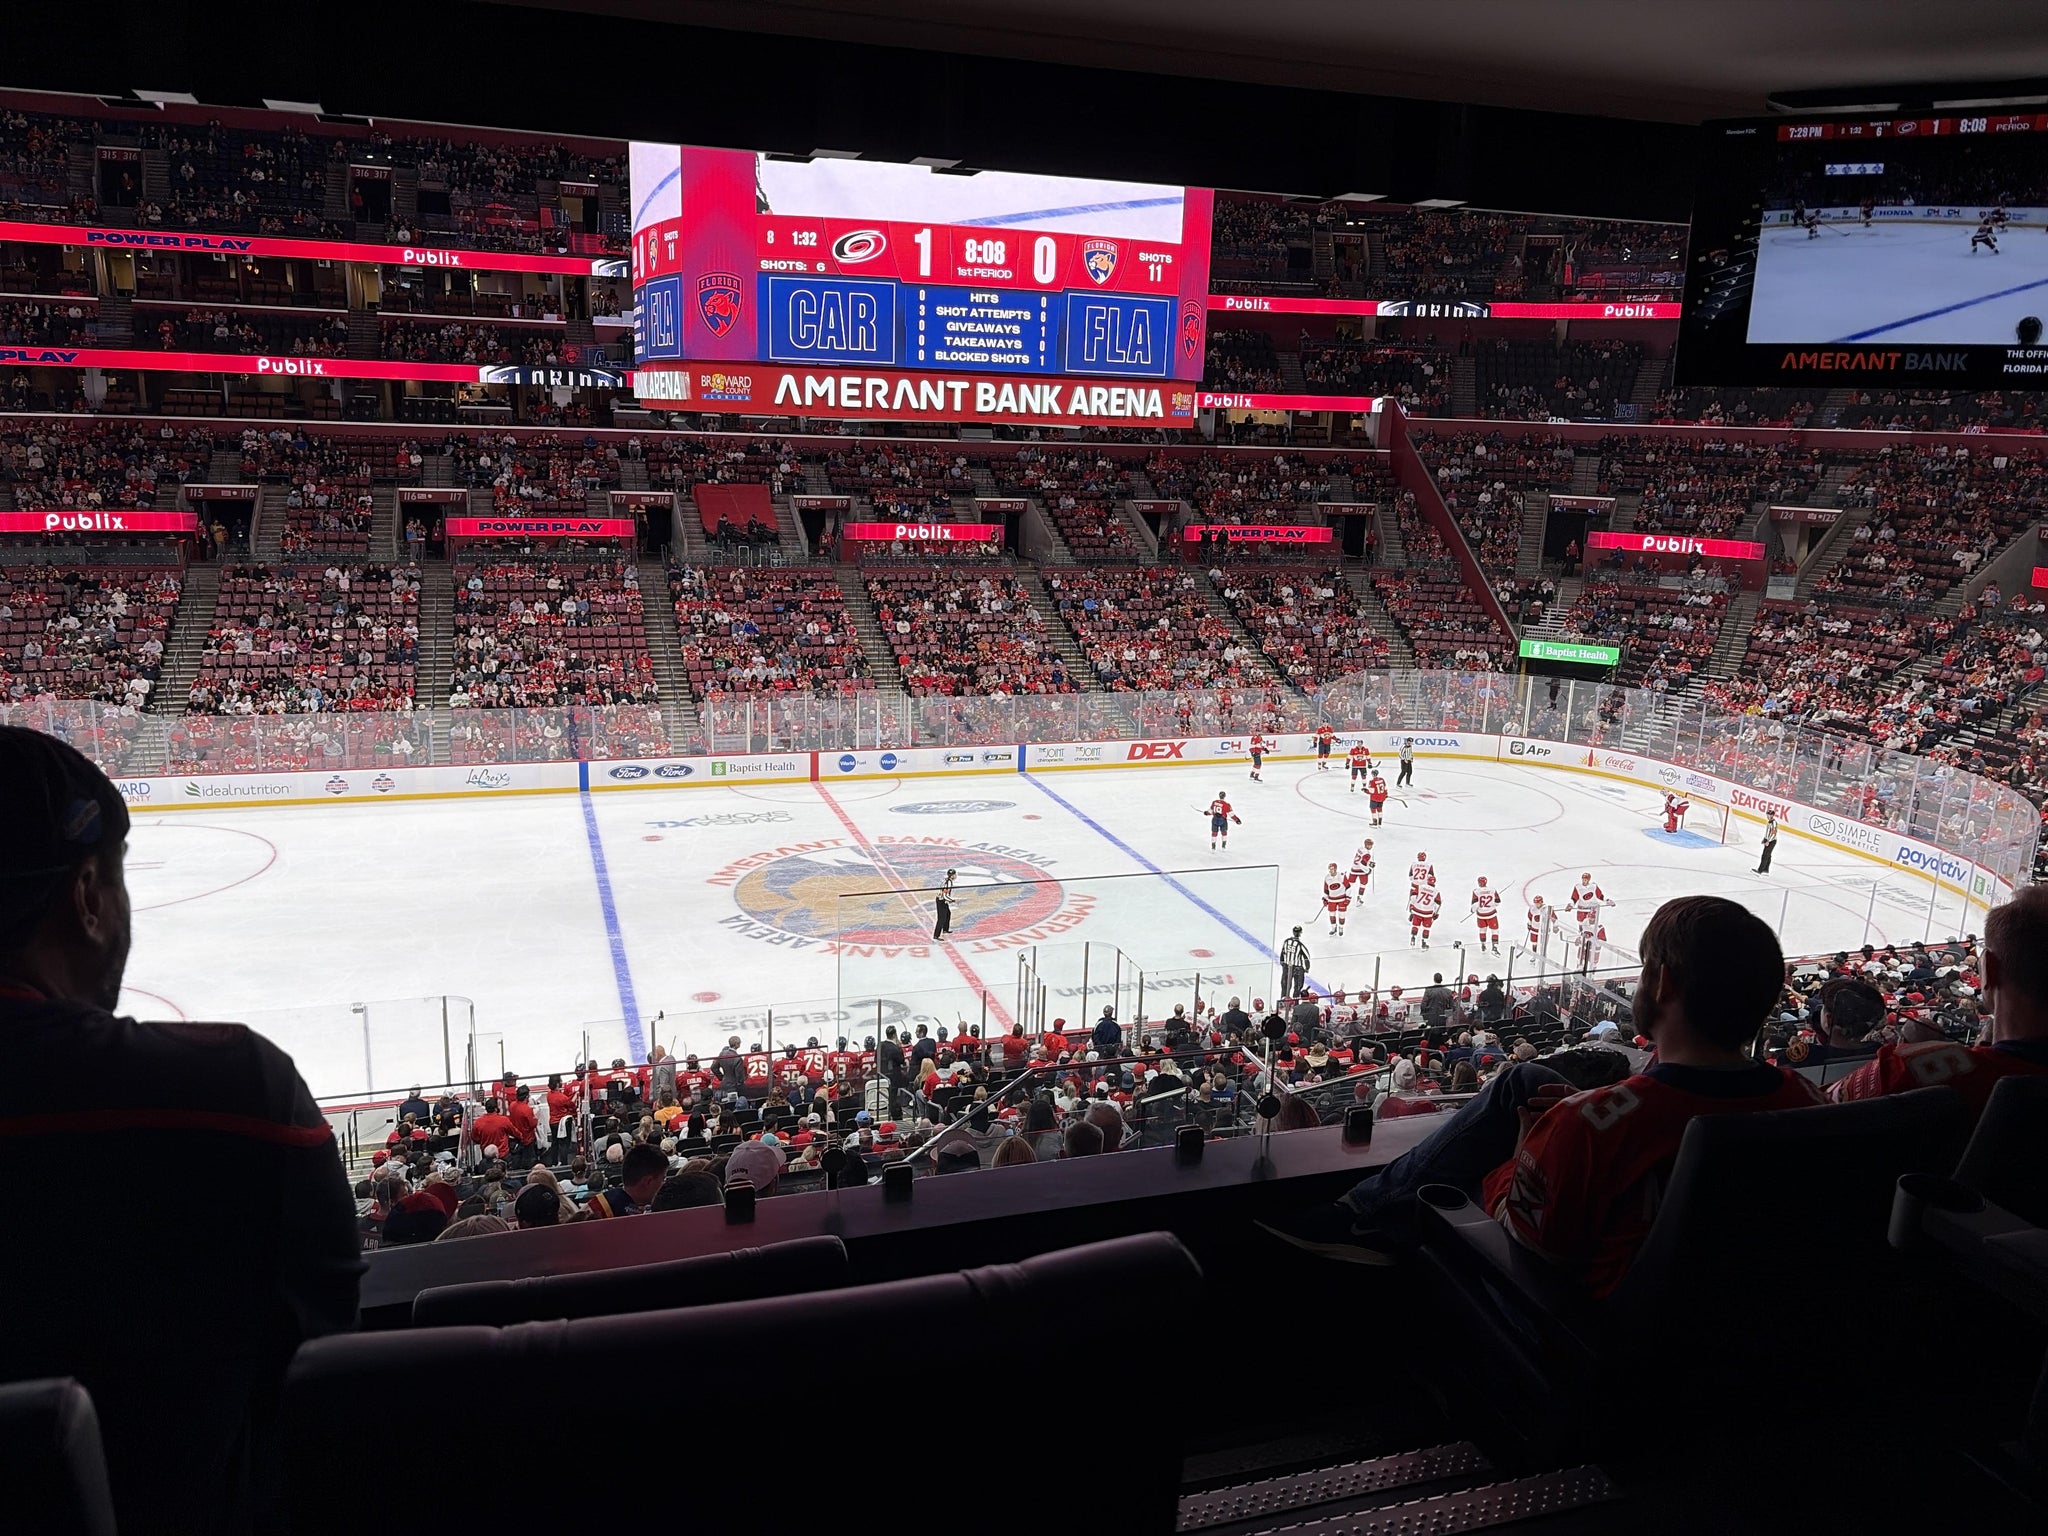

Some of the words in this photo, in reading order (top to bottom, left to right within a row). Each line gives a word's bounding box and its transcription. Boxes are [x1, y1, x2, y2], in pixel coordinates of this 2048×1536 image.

[1809, 127, 1822, 137] PM
[1932, 120, 1940, 134] 1
[1959, 118, 1988, 133] 8:08
[1996, 122, 2030, 131] PERIOD
[87, 232, 180, 246] POWER
[184, 232, 252, 250] PLAY
[664, 230, 679, 242] SHOTS
[766, 230, 775, 245] 8
[792, 230, 818, 246] 1:32
[668, 242, 675, 261] 11
[914, 228, 932, 276] 1
[964, 238, 1006, 265] 8:08
[1086, 242, 1116, 252] FLORIDA
[403, 249, 460, 266] Publix
[1034, 236, 1056, 284] 0
[1138, 252, 1173, 264] SHOTS
[760, 260, 807, 272] SHOTS:
[816, 262, 826, 272] 6
[957, 266, 972, 276] 1st
[974, 267, 1012, 279] PERIOD
[1148, 264, 1162, 282] 11
[700, 276, 738, 290] FLORIDA
[918, 289, 926, 301] 0
[970, 292, 1000, 304] HITS
[1040, 296, 1047, 308] 0
[1226, 298, 1270, 311] Publix
[918, 304, 926, 317] 3
[936, 306, 968, 318] SHOT
[970, 308, 1032, 321] ATTEMPTS
[1604, 305, 1654, 318] Publix
[789, 289, 877, 352] CAR
[918, 319, 926, 332] 0
[946, 320, 1022, 335] GIVEAWAYS
[1040, 326, 1046, 338] 1
[1084, 305, 1152, 364] FLA
[918, 334, 926, 346] 0
[944, 336, 1023, 350] TAKEAWAYS
[1039, 340, 1046, 352] 0
[0, 350, 78, 363] PLAY
[918, 348, 926, 361] 0
[935, 350, 990, 363] BLOCKED
[990, 353, 1030, 365] SHOTS
[1040, 354, 1045, 366] 1
[2006, 350, 2024, 358] THE
[258, 358, 324, 376] Publix
[1781, 352, 1902, 370] AMERANT
[1904, 353, 1969, 371] BANK
[2003, 364, 2042, 373] FLORIDA
[649, 372, 682, 400] ARENA
[700, 373, 752, 390] BROWARD
[724, 386, 752, 395] COUNTY
[774, 374, 970, 411] AMERANT
[975, 382, 1063, 415] BANK
[1066, 386, 1165, 418] ARENA
[1204, 395, 1252, 408] Publix
[190, 488, 204, 497] 115
[241, 488, 255, 498] 116
[404, 492, 417, 501] 116
[450, 492, 463, 502] 117
[614, 494, 626, 504] 117
[658, 495, 670, 504] 118
[796, 499, 808, 508] 118
[836, 499, 848, 508] 119
[1012, 502, 1024, 510] 120
[1168, 503, 1178, 511] 121
[1323, 506, 1334, 514] 121
[1356, 506, 1368, 514] 122
[1551, 498, 1564, 507] 123
[1598, 500, 1610, 509] 124
[46, 514, 124, 530] Publix
[1780, 511, 1794, 520] 124
[1822, 512, 1837, 522] 125
[478, 522, 550, 532] POWER
[552, 523, 604, 532] PLAY
[896, 525, 951, 540] Publix
[1264, 530, 1306, 538] PLAY
[1643, 536, 1704, 555] Publix
[1546, 646, 1577, 658] Baptist
[1578, 650, 1609, 661] Health
[1082, 747, 1102, 757] JOINT
[1126, 742, 1188, 760] DEX
[1220, 740, 1242, 750] CH
[1045, 748, 1065, 758] JOINT
[617, 766, 642, 778] Ford
[661, 764, 686, 778] Ford
[730, 762, 762, 774] Baptist
[765, 762, 796, 772] Health
[1658, 768, 1670, 779] Hard
[1670, 771, 1682, 782] Rock
[466, 768, 508, 785] LaCroix
[202, 784, 290, 798] idealnutrition
[1376, 784, 1385, 794] 13
[1730, 788, 1792, 823] SEATGEEK
[1838, 822, 1882, 847] SIMPLE
[1836, 834, 1880, 853] COSMETICS
[705, 838, 846, 886] AMERANT
[878, 836, 967, 848] BANK
[968, 842, 1059, 868] ARENA
[1896, 846, 1968, 882] payactiv
[1414, 868, 1427, 880] 23
[1417, 892, 1434, 906] 75
[1479, 895, 1493, 908] 62
[971, 892, 1098, 953] AMERANT
[717, 914, 821, 950] ARENA
[818, 940, 930, 958] BANK
[1055, 975, 1224, 998] AutoNation
[716, 1010, 851, 1032] CELSIUS
[748, 1062, 768, 1077] 29
[804, 1054, 824, 1071] 79
[732, 1168, 749, 1176] CHAMPS
